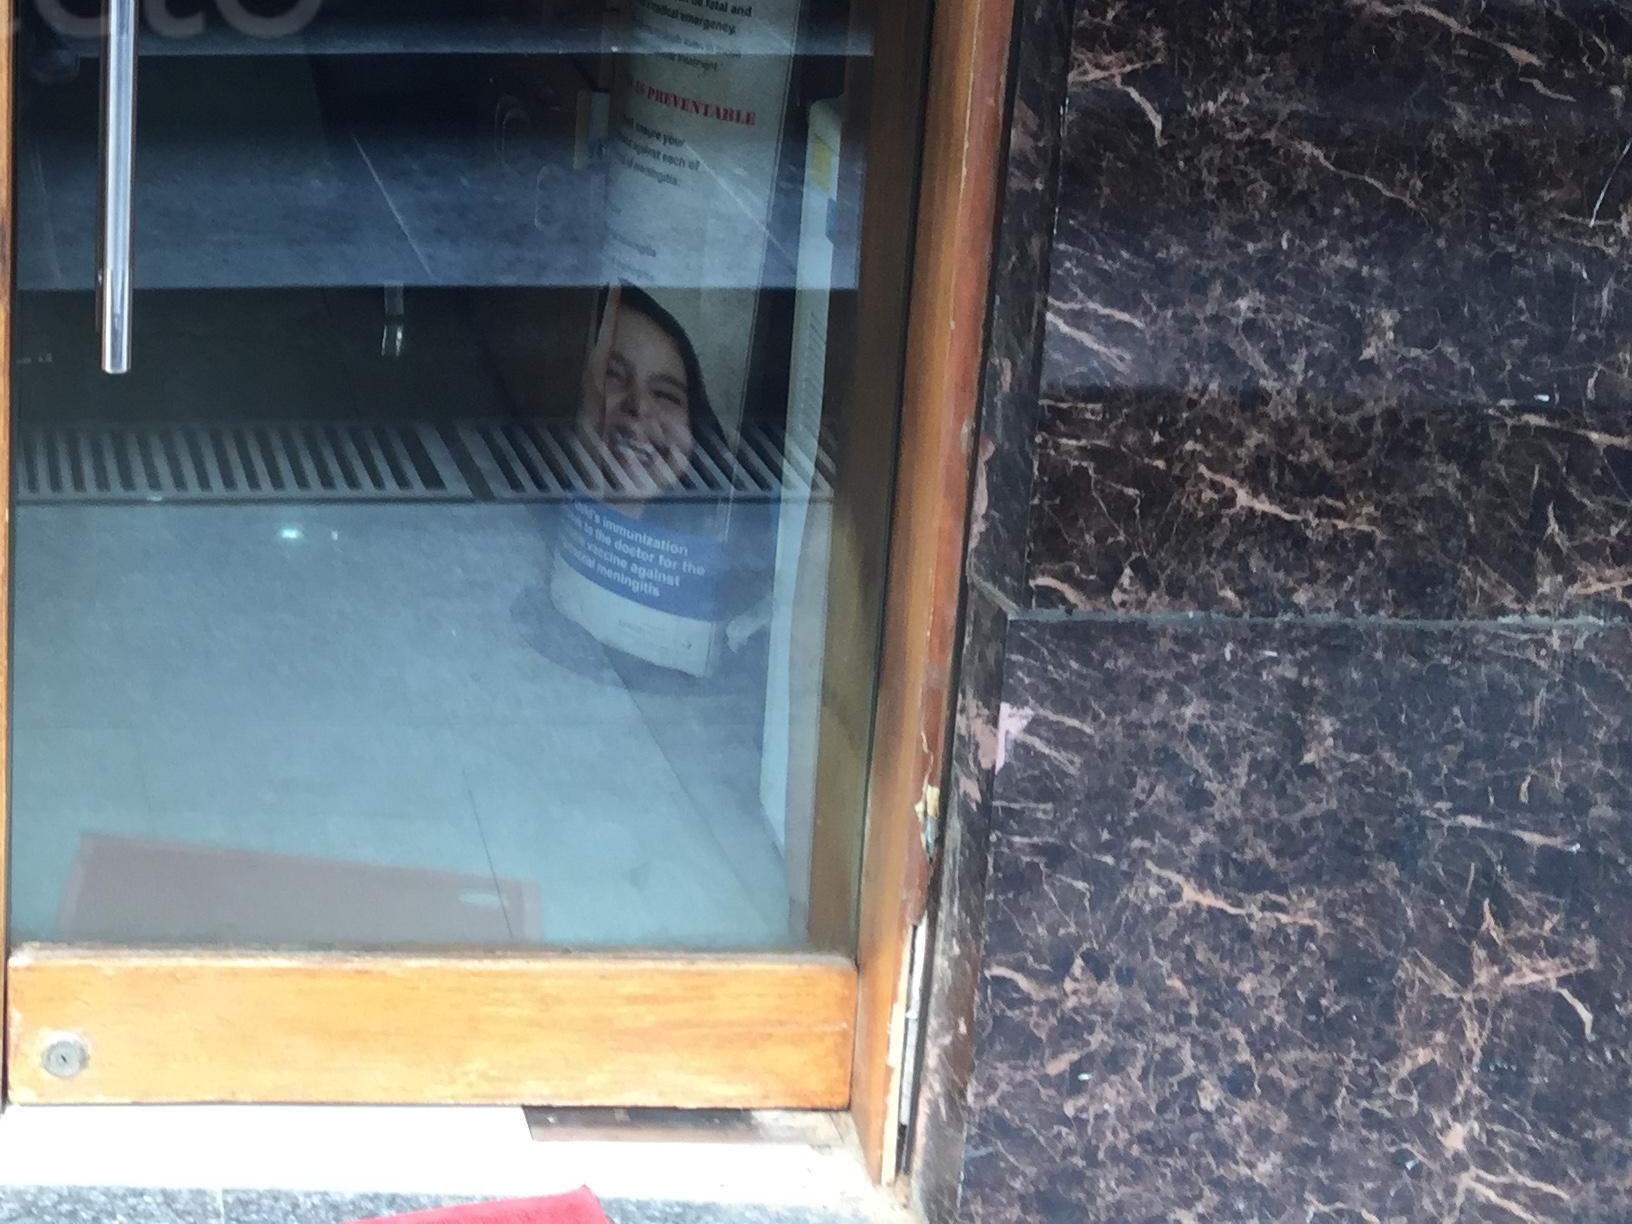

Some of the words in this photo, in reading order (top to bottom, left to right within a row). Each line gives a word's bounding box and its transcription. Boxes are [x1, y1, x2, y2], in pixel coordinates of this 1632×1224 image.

[647, 87, 756, 125] PREVENTABLE
[595, 528, 611, 546] the
[614, 539, 655, 563] doctor
[658, 555, 678, 569] for
[682, 561, 706, 576] the
[602, 517, 688, 556] immunization
[587, 542, 628, 569] vaccine
[631, 563, 680, 587] against
[596, 563, 660, 597] meningitis
